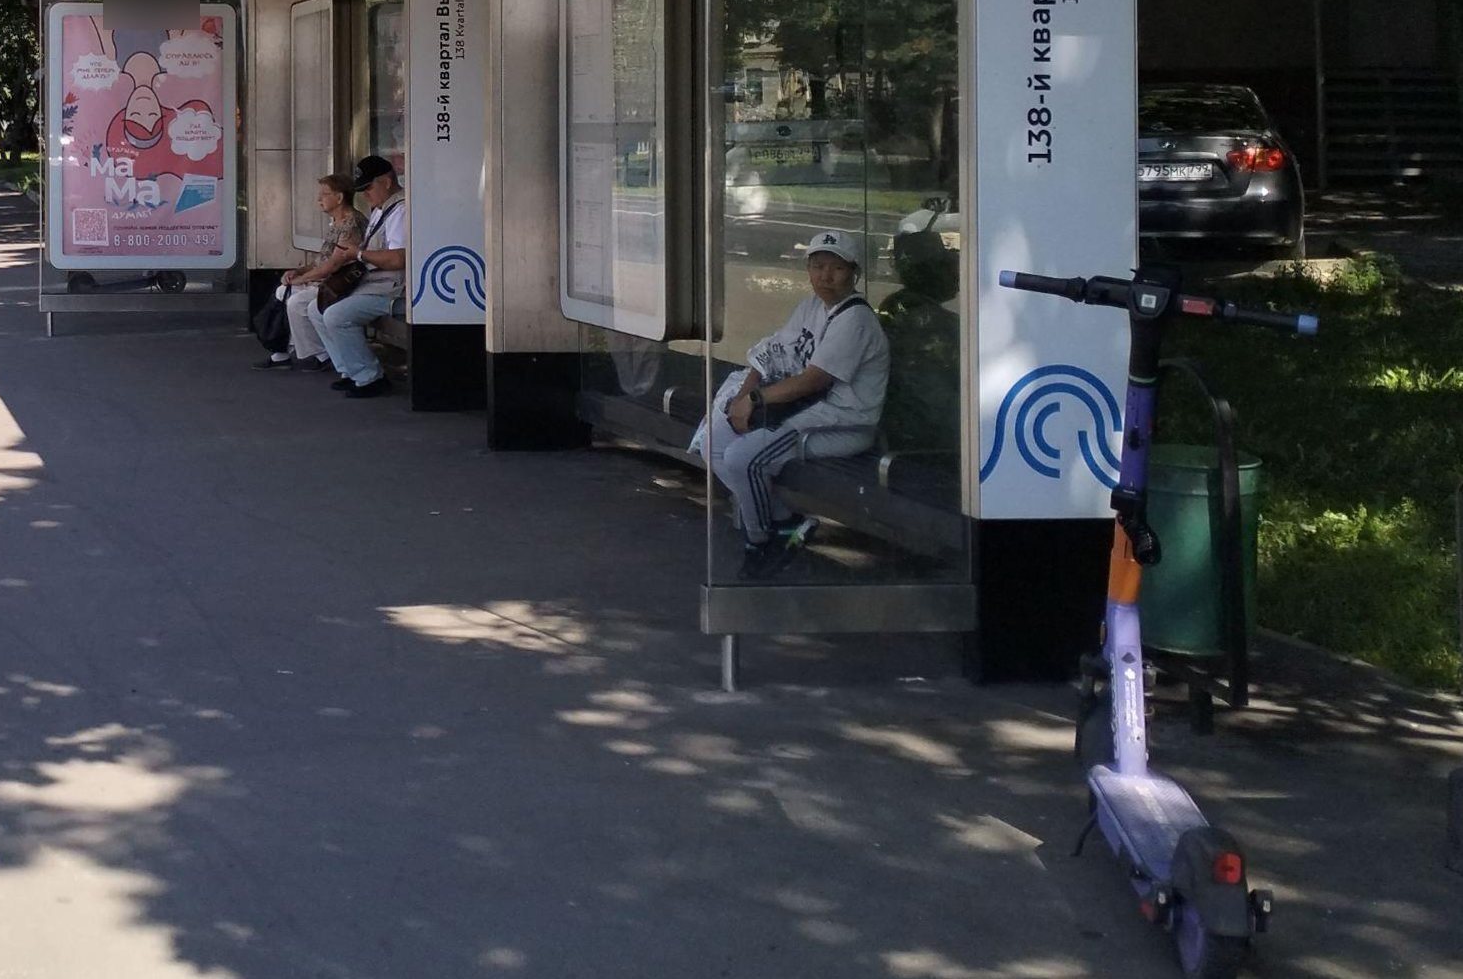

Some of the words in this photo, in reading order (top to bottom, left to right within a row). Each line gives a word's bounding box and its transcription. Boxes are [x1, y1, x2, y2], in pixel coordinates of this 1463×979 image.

[455, 0, 465, 39] Kvartal
[439, 21, 454, 91] квартал
[455, 40, 465, 60] 138
[437, 95, 451, 142] 138-й
[1027, 73, 1052, 164] 138-й
